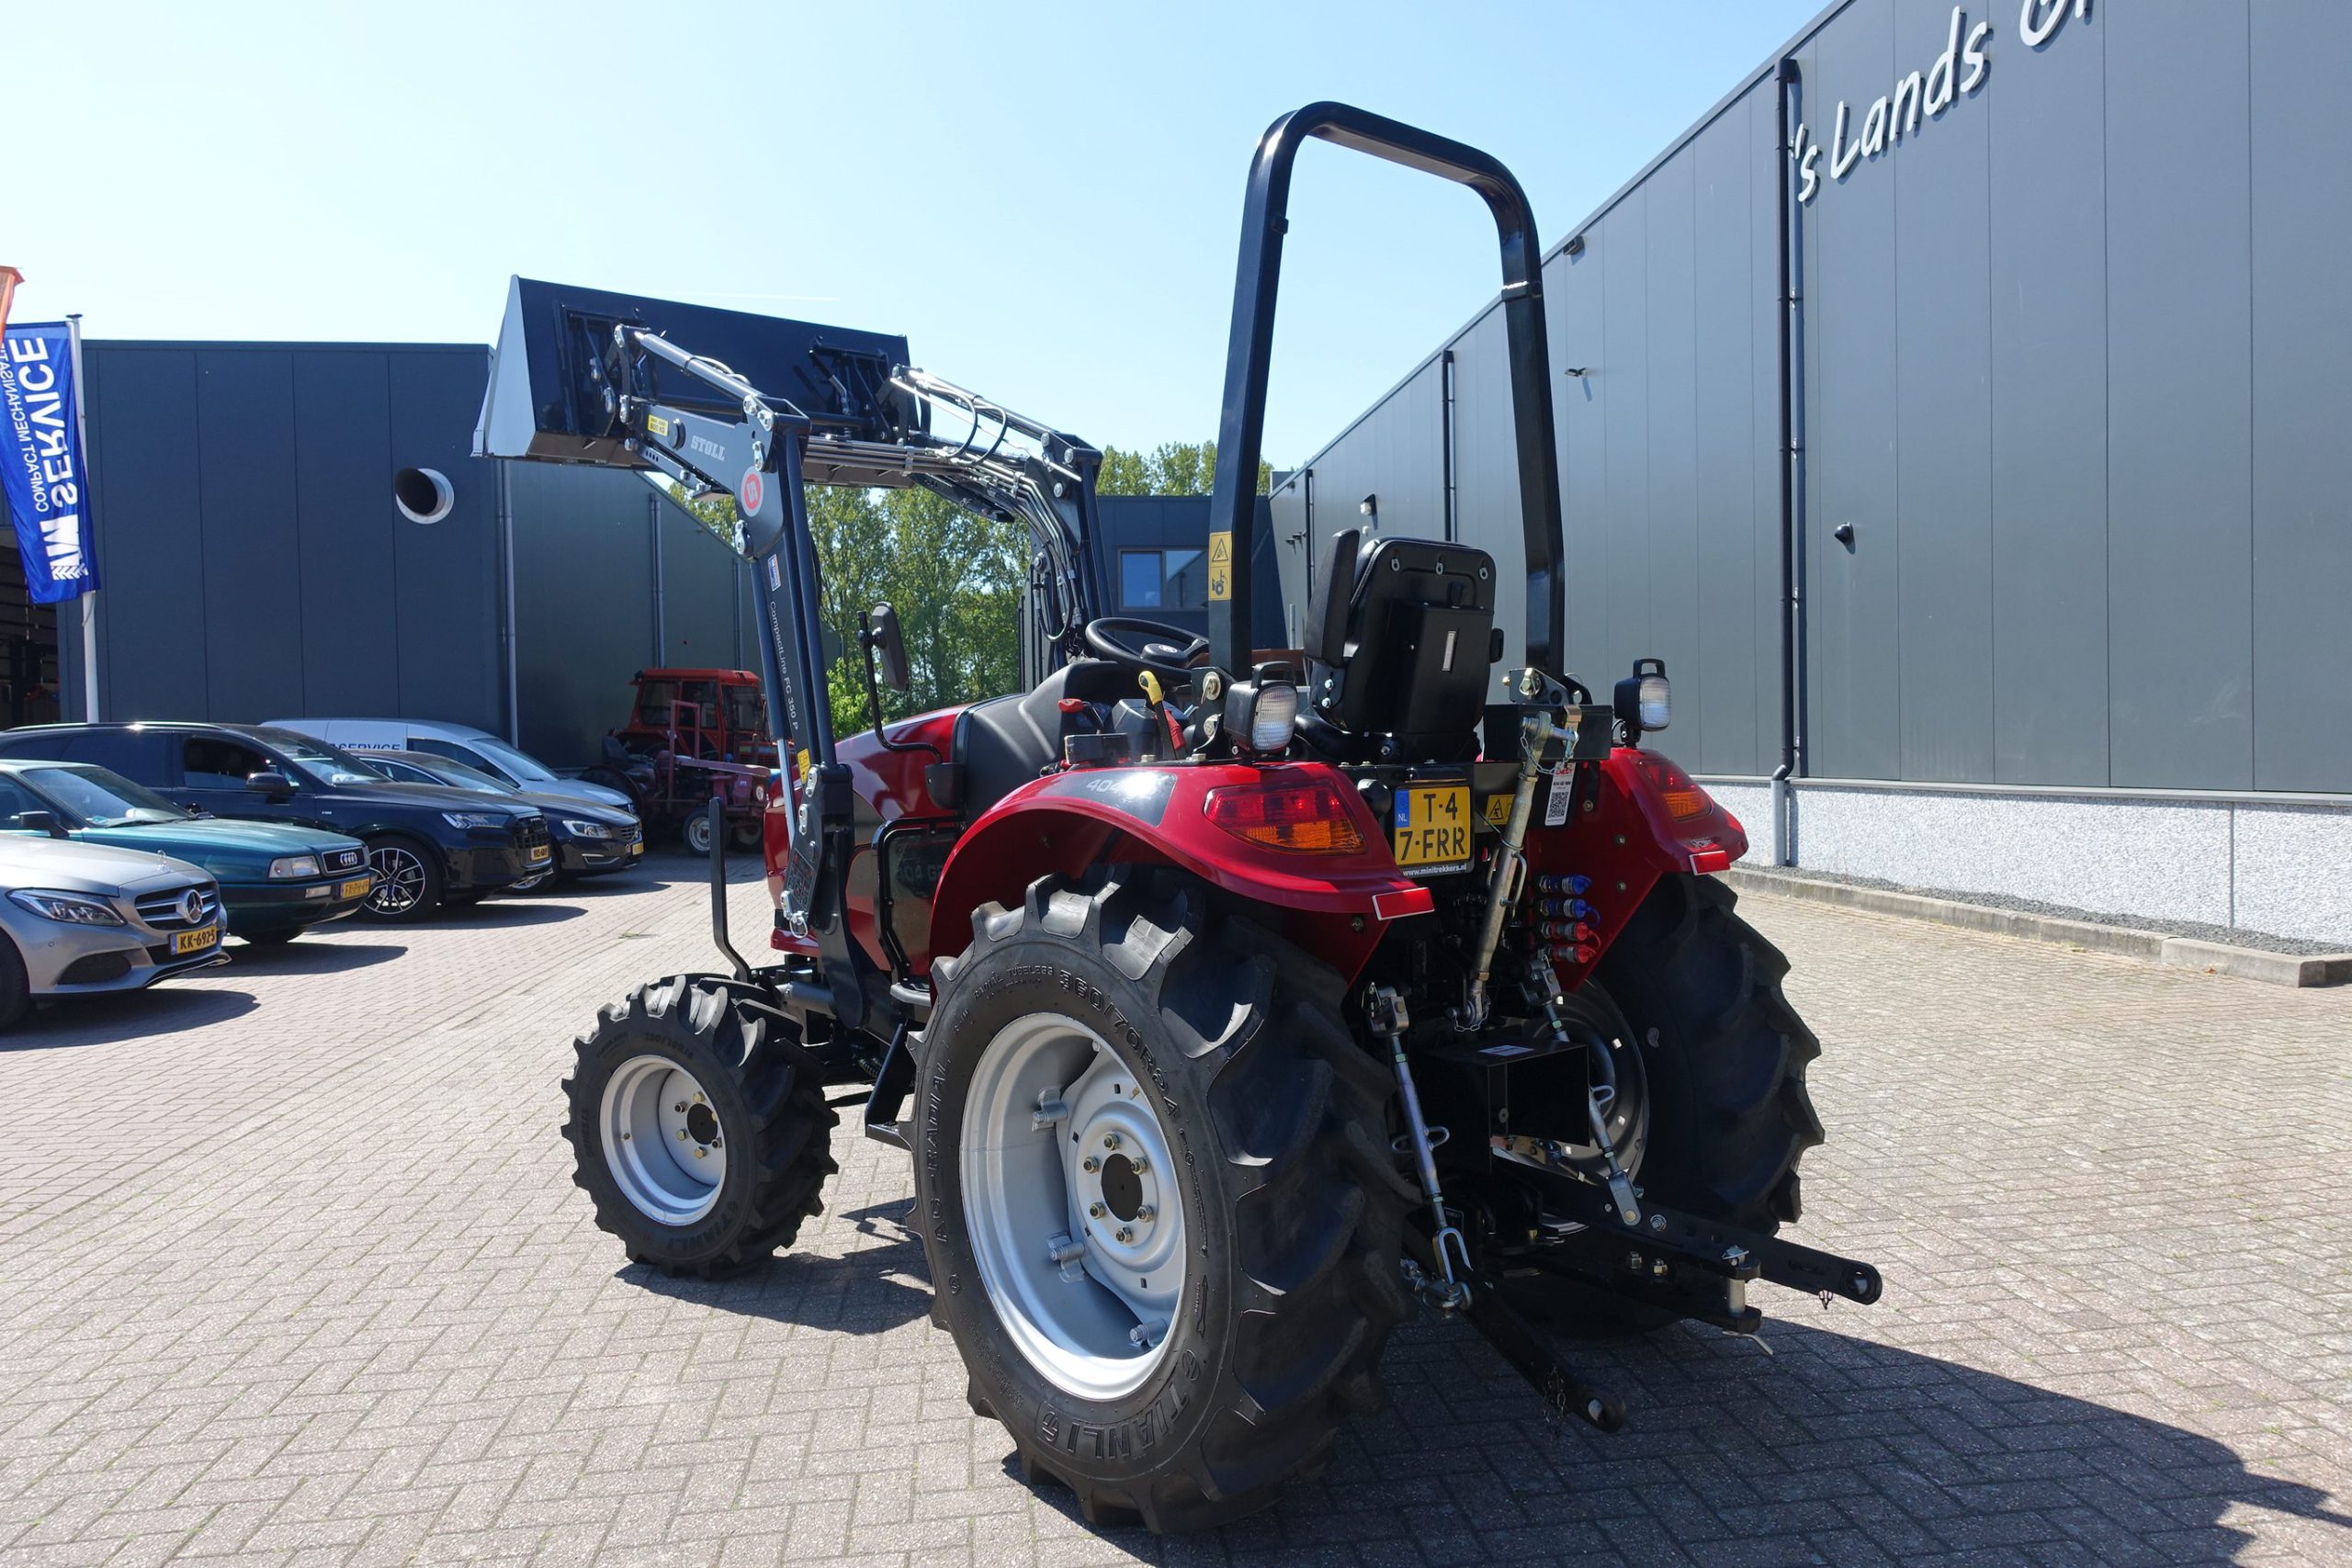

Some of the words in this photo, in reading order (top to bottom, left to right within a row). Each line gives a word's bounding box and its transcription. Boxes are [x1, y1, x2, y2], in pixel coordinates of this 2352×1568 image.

[1794, 123, 1819, 203] 's
[1829, 6, 1989, 180] Lands
[690, 434, 726, 462] STOLL
[770, 601, 787, 674] CompactLine
[784, 676, 792, 694] FC
[787, 696, 797, 718] 350
[792, 720, 799, 731] P
[1397, 813, 1408, 822] NL
[1423, 792, 1458, 822] T-4
[1399, 827, 1465, 861] 7-FRR
[1403, 863, 1467, 876] www.minitrekkers.nl
[1058, 968, 1181, 1120] 360/70R24
[1065, 1382, 1192, 1461] TIANLI
